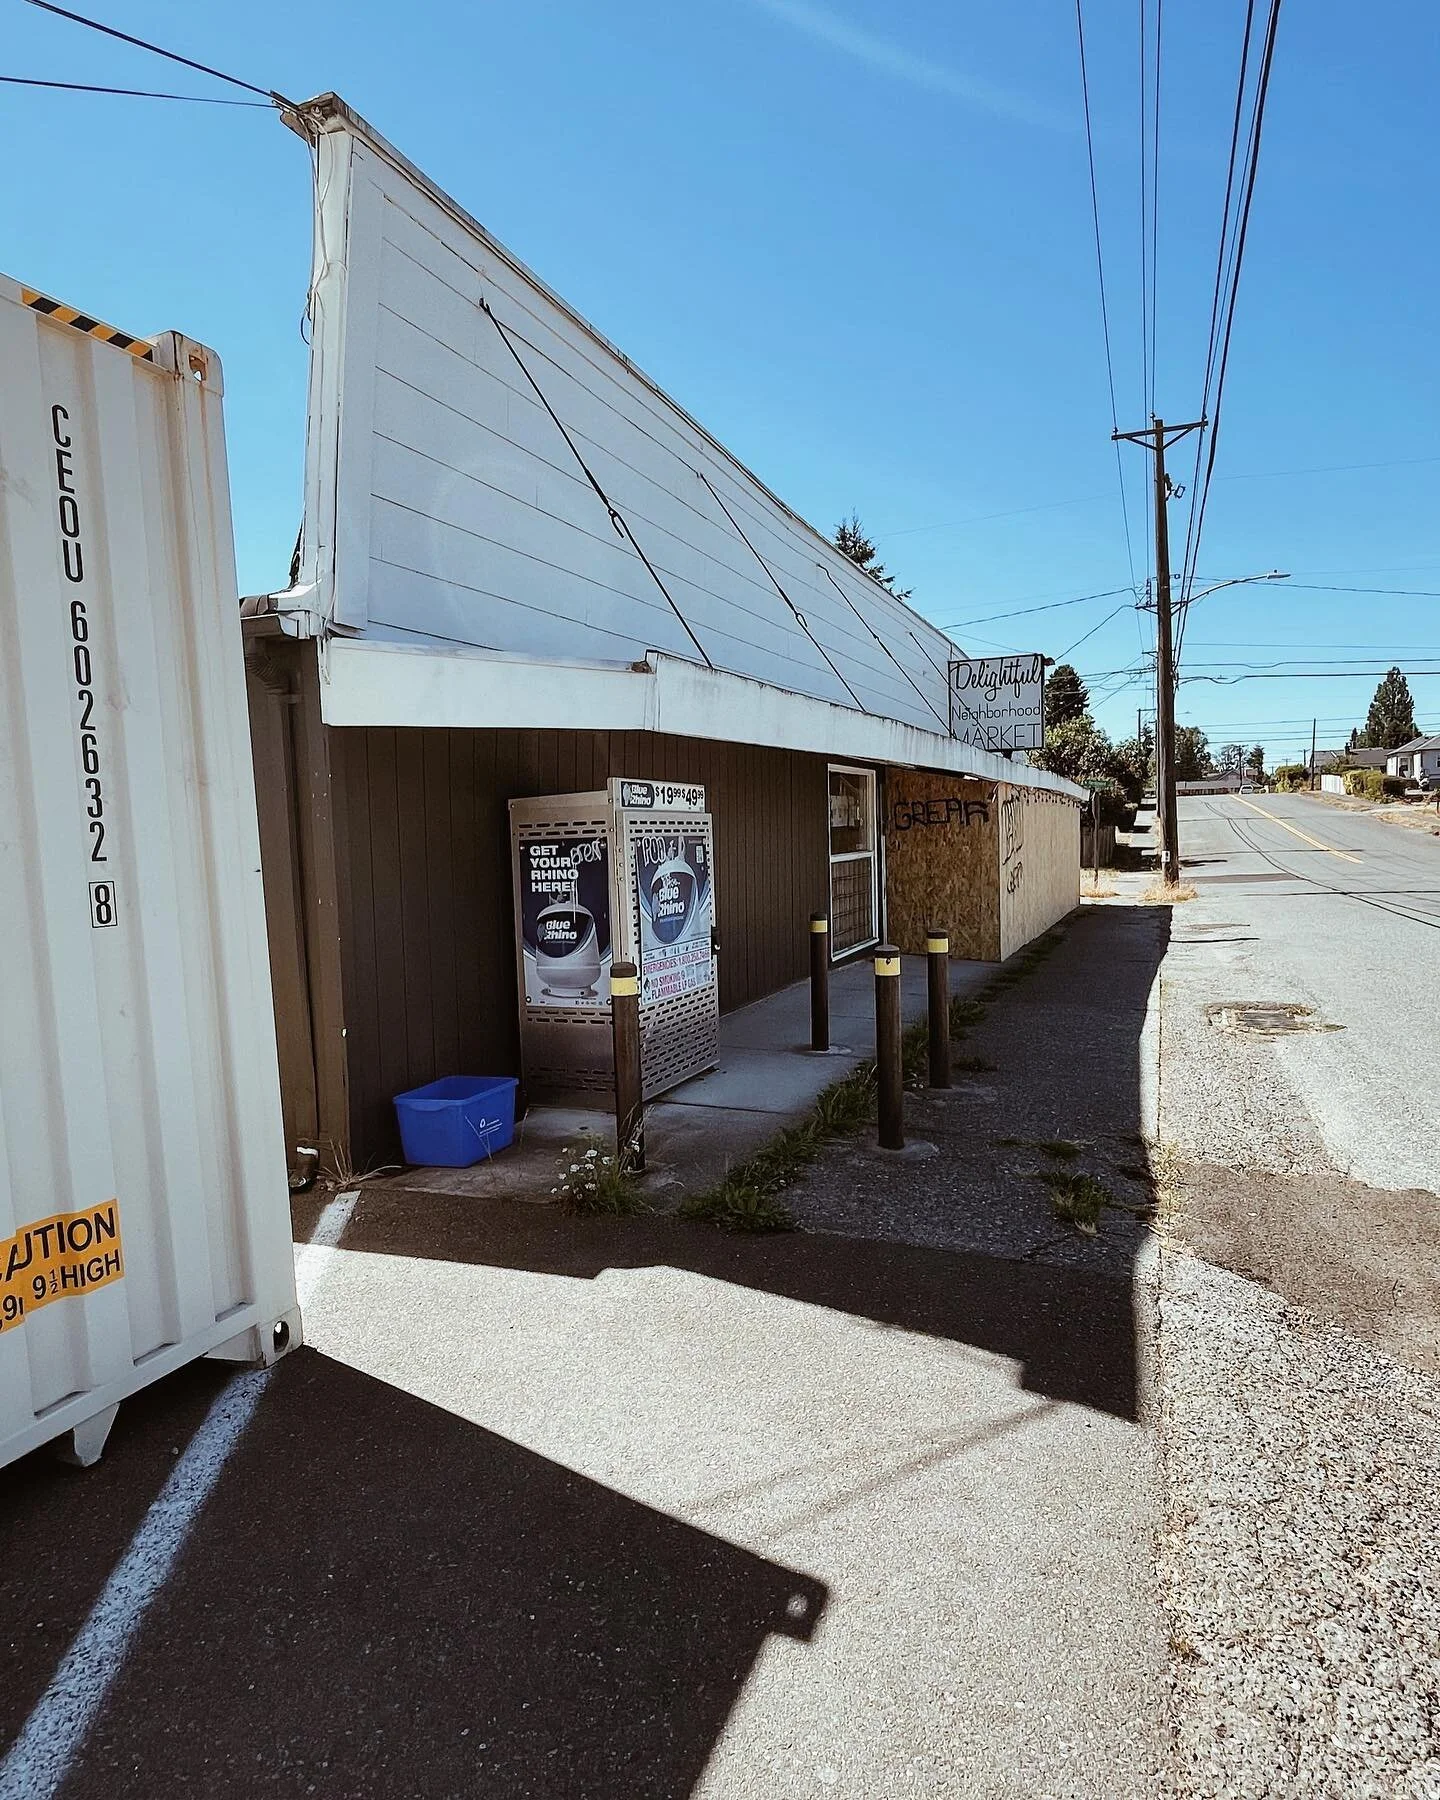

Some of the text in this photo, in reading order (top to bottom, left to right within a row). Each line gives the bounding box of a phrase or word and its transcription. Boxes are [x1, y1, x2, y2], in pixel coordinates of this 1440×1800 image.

[52, 404, 112, 925] CEOU 602632 8
[950, 654, 1041, 701] Delightful
[952, 699, 1041, 726] Neighborhood
[952, 722, 1041, 750] MARKET
[631, 785, 648, 796] Blue
[530, 845, 559, 856] GET
[530, 857, 571, 868] YOUR
[531, 869, 579, 880] RHINO
[531, 880, 575, 892] HERE!
[659, 886, 679, 902] Blue
[657, 900, 685, 918] Rhino
[545, 920, 571, 930] Blue
[544, 930, 577, 940] Rhino
[0, 1207, 116, 1282] AUTION
[60, 1249, 120, 1289] HIGH
